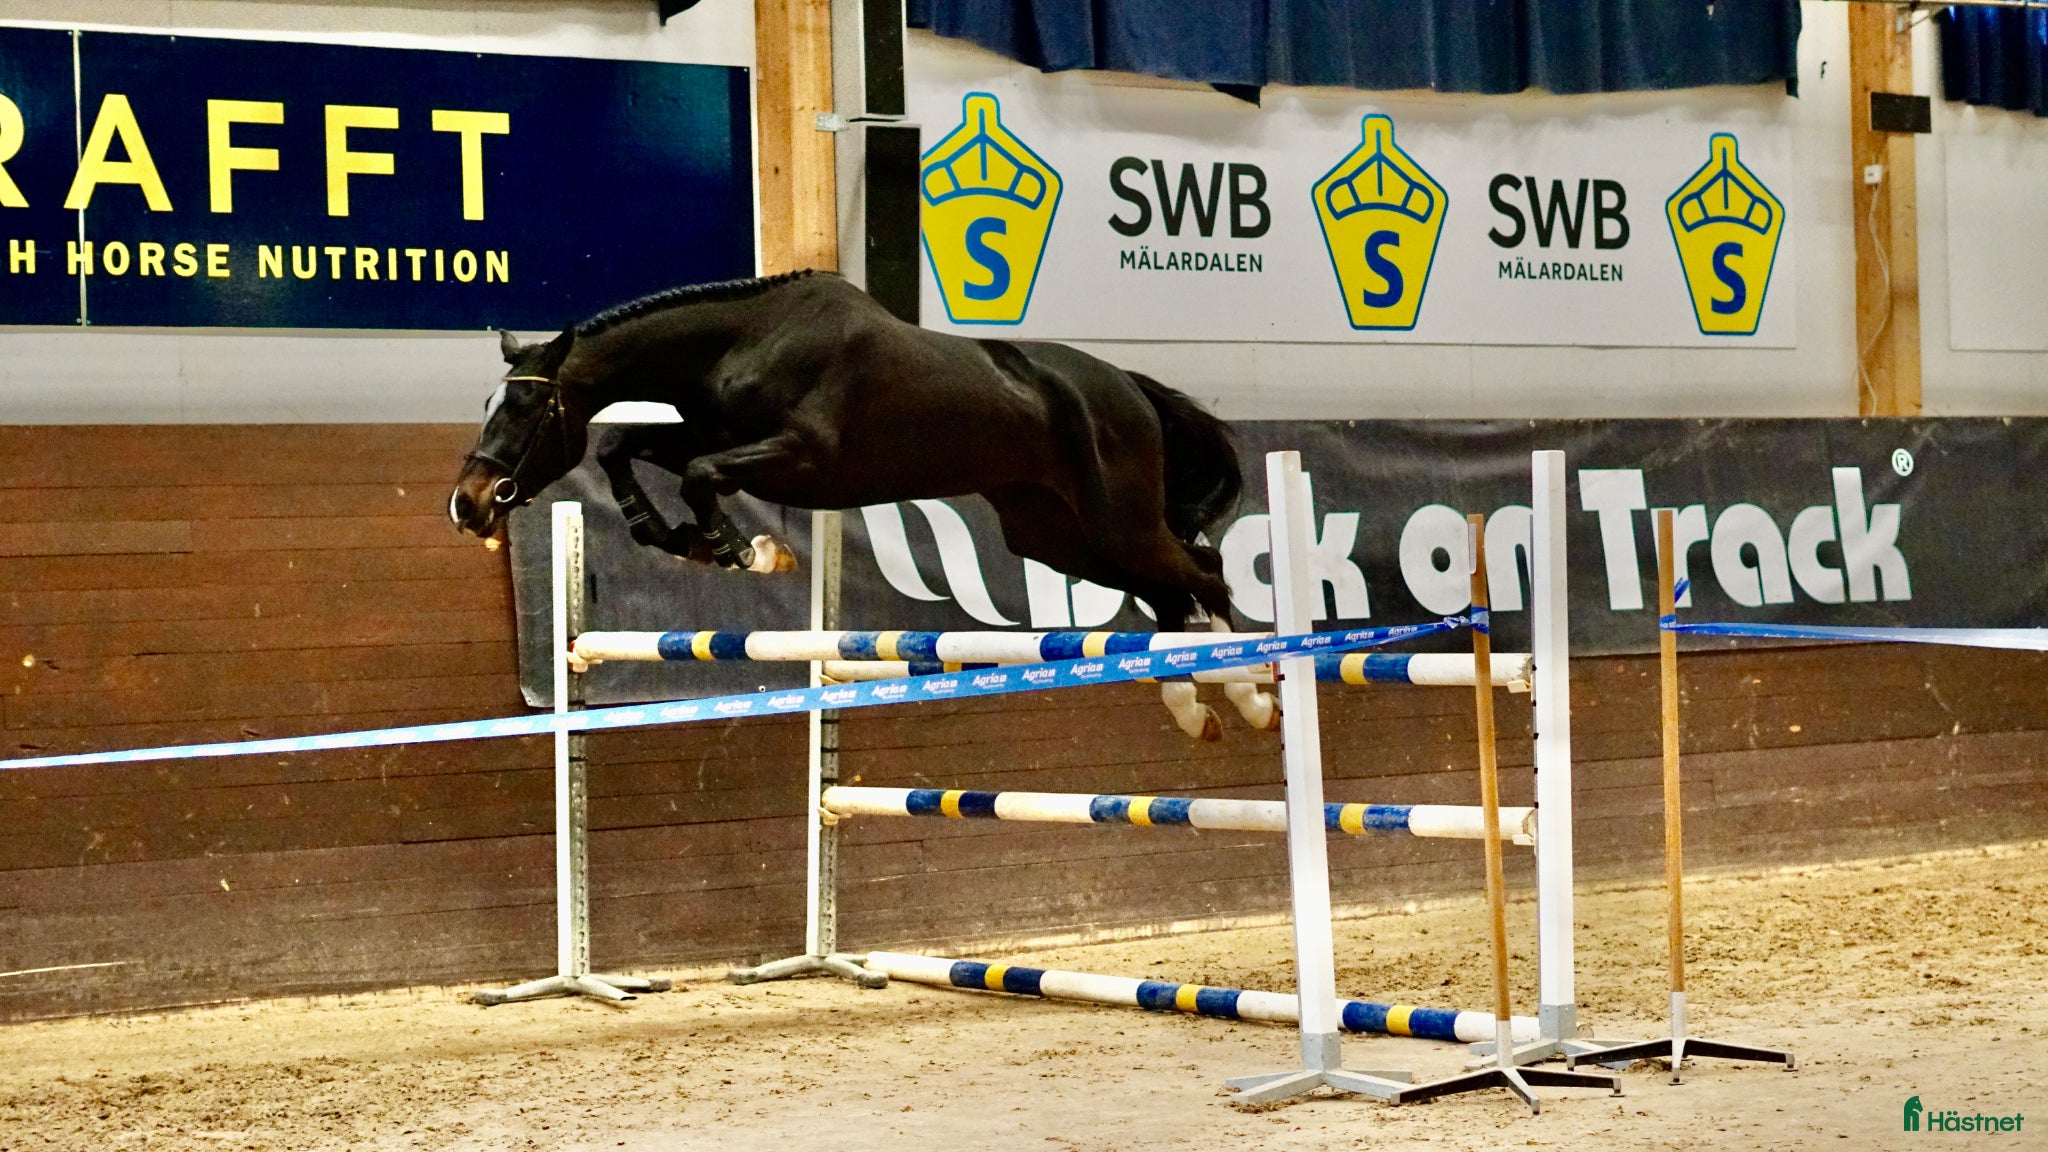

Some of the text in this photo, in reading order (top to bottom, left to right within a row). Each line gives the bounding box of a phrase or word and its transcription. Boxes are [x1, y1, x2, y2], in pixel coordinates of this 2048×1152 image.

[1107, 155, 1272, 239] SWB
[1487, 173, 1630, 250] SWB
[67, 240, 230, 278] HORSE
[258, 244, 510, 283] NUTRITION
[963, 217, 1010, 301] S
[1119, 244, 1263, 273] MÄLARDALEN
[1363, 231, 1403, 308] S
[1497, 256, 1624, 283] MÄLARDALEN
[1711, 243, 1746, 314] S
[1578, 466, 1912, 611] Track
[1301, 635, 1324, 648] Agria
[1345, 631, 1368, 642] Agria
[1211, 645, 1235, 659] Agria
[1256, 640, 1280, 654] Agria
[1118, 657, 1144, 671] Agria
[1165, 651, 1190, 665] Agria
[1022, 668, 1048, 682] Agria
[1071, 662, 1096, 676] Agria
[922, 679, 950, 693] Agria
[973, 673, 999, 687] Agria
[820, 689, 848, 702] Agria
[872, 684, 898, 697] Agria
